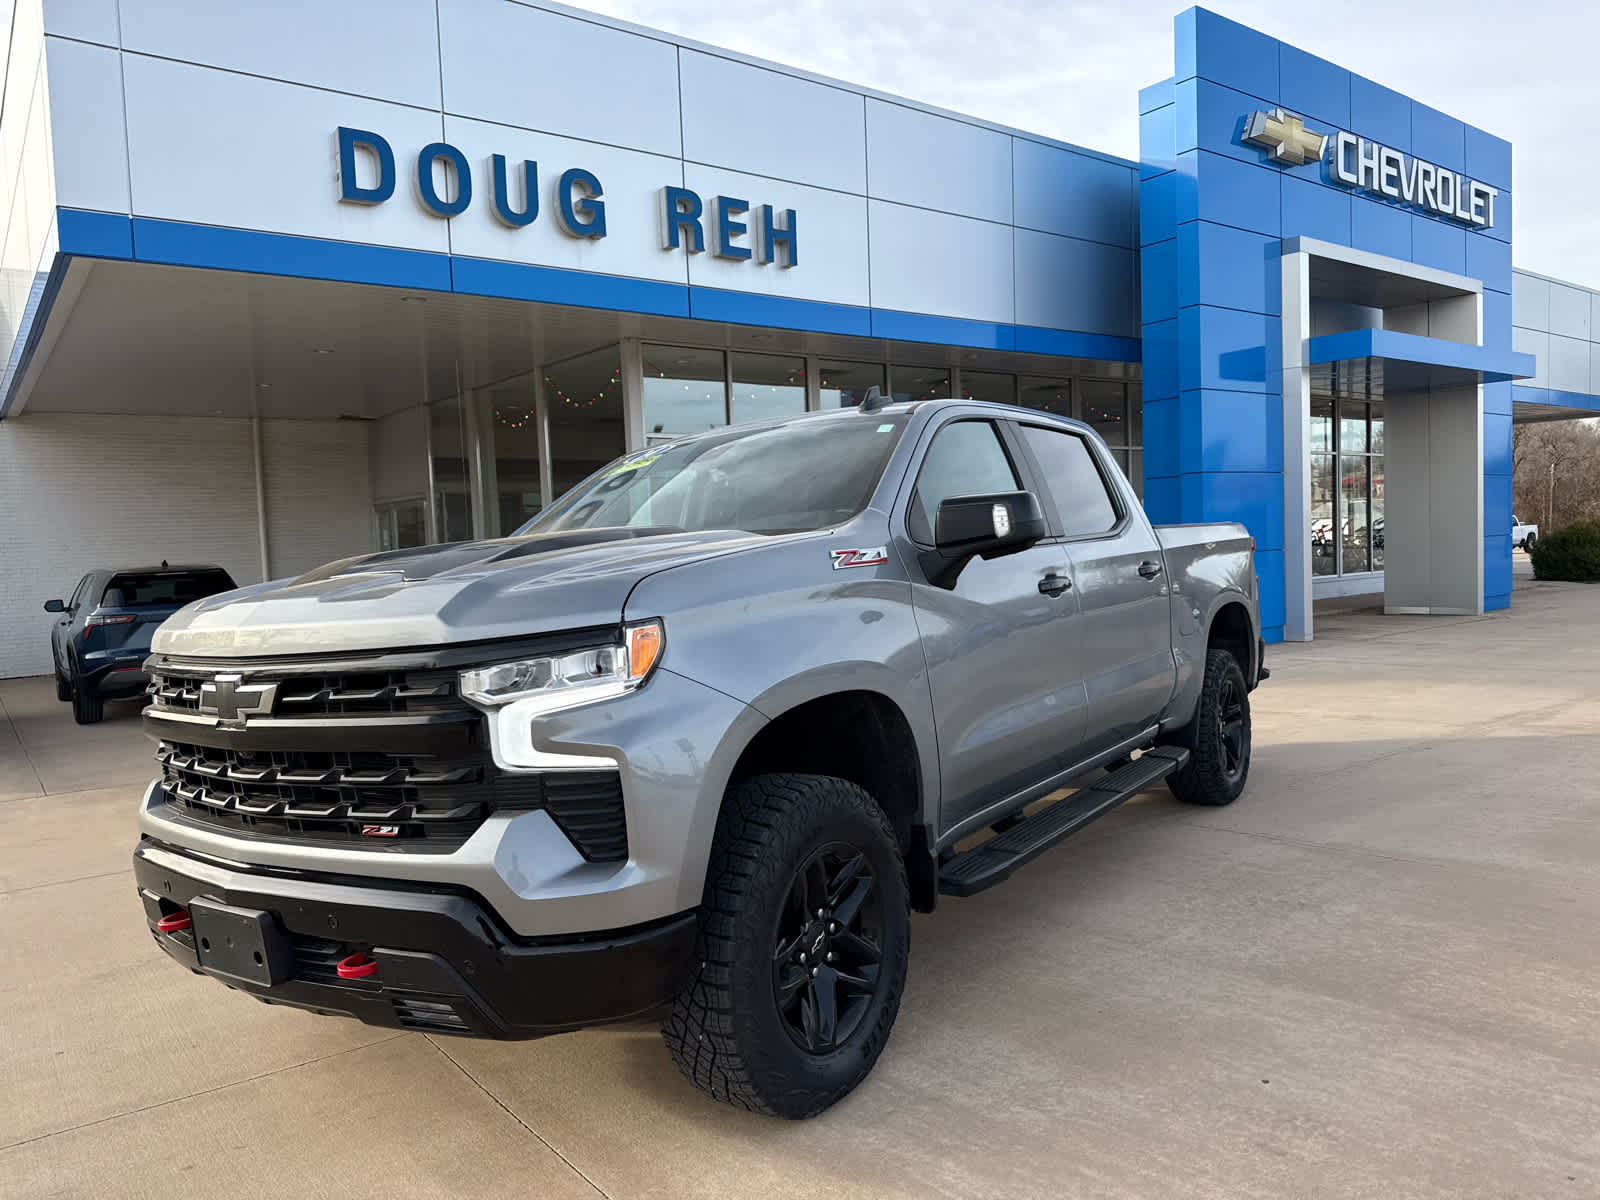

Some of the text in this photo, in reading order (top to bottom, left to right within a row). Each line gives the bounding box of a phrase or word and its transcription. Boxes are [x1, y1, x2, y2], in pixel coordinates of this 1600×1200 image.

[336, 126, 798, 268] DOUG REH
[1335, 130, 1499, 229] CHEVROLET
